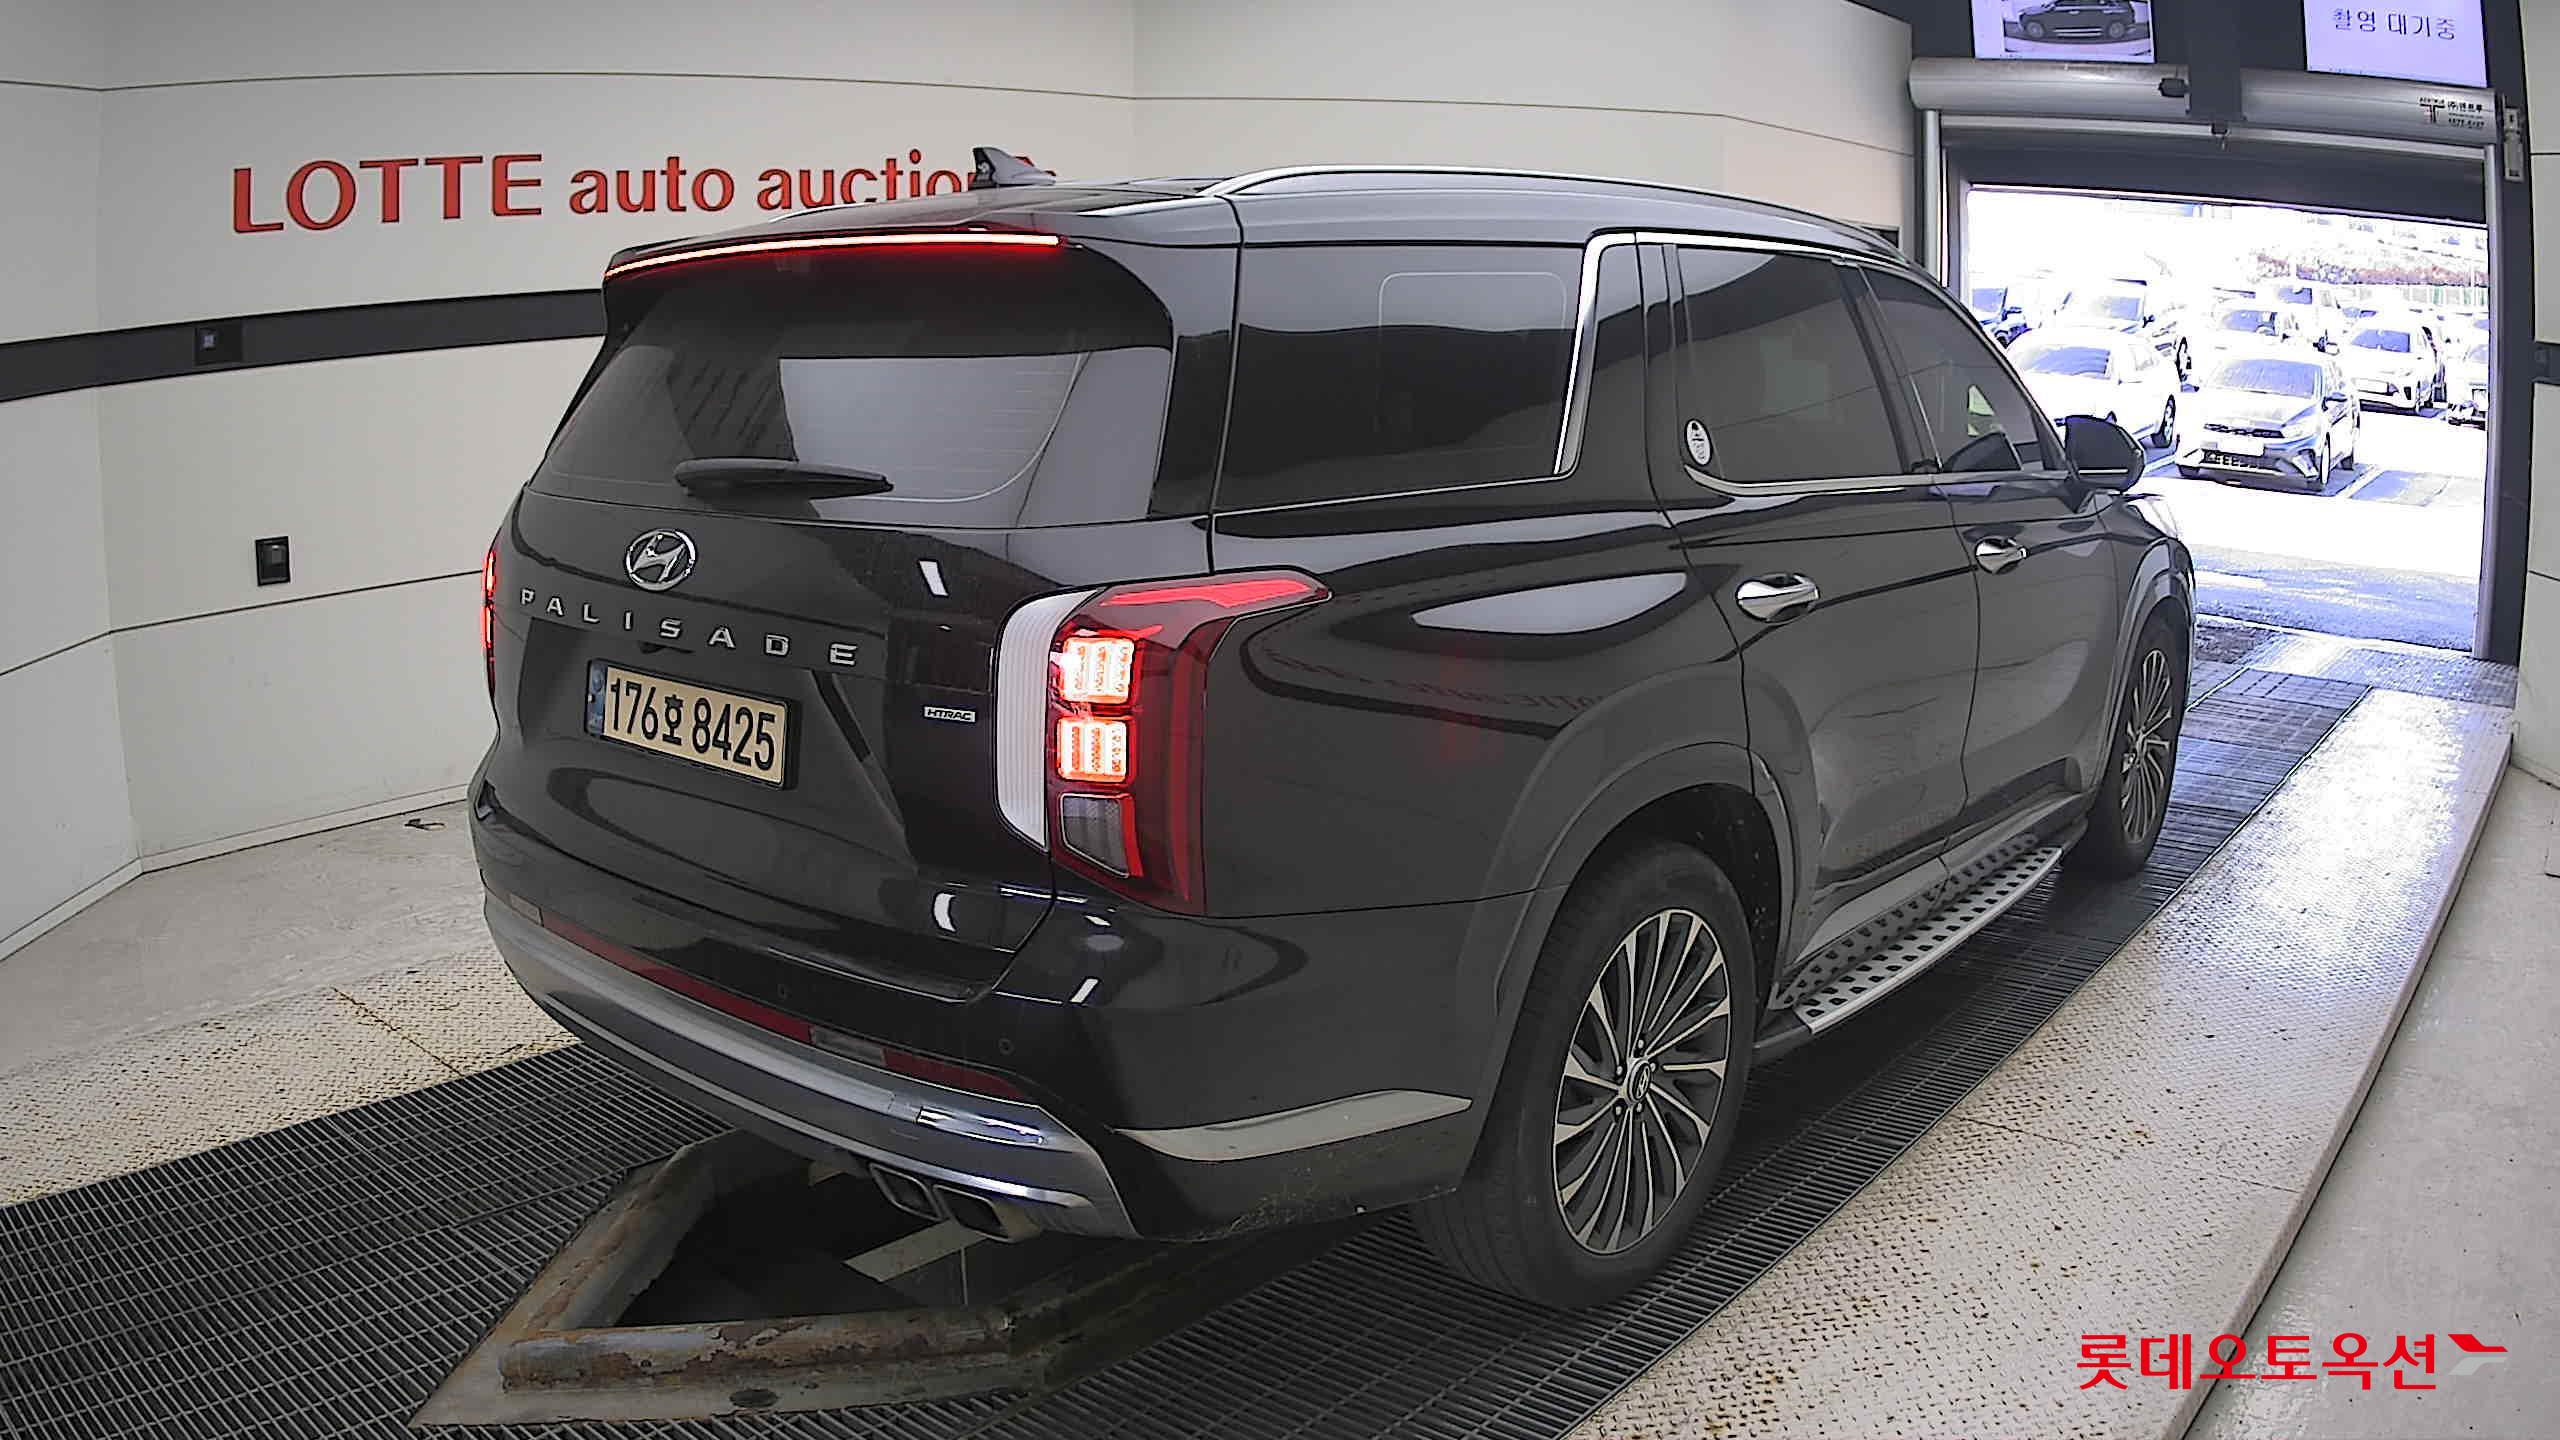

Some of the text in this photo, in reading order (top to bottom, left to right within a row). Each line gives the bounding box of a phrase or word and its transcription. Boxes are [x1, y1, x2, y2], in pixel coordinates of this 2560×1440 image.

[2387, 13, 2456, 41] 대기중
[233, 153, 543, 235] LOTTE
[569, 155, 737, 214] auto
[519, 588, 858, 667] PALISADE
[610, 677, 777, 771] 176호 8425
[926, 707, 974, 721] HTRAC
